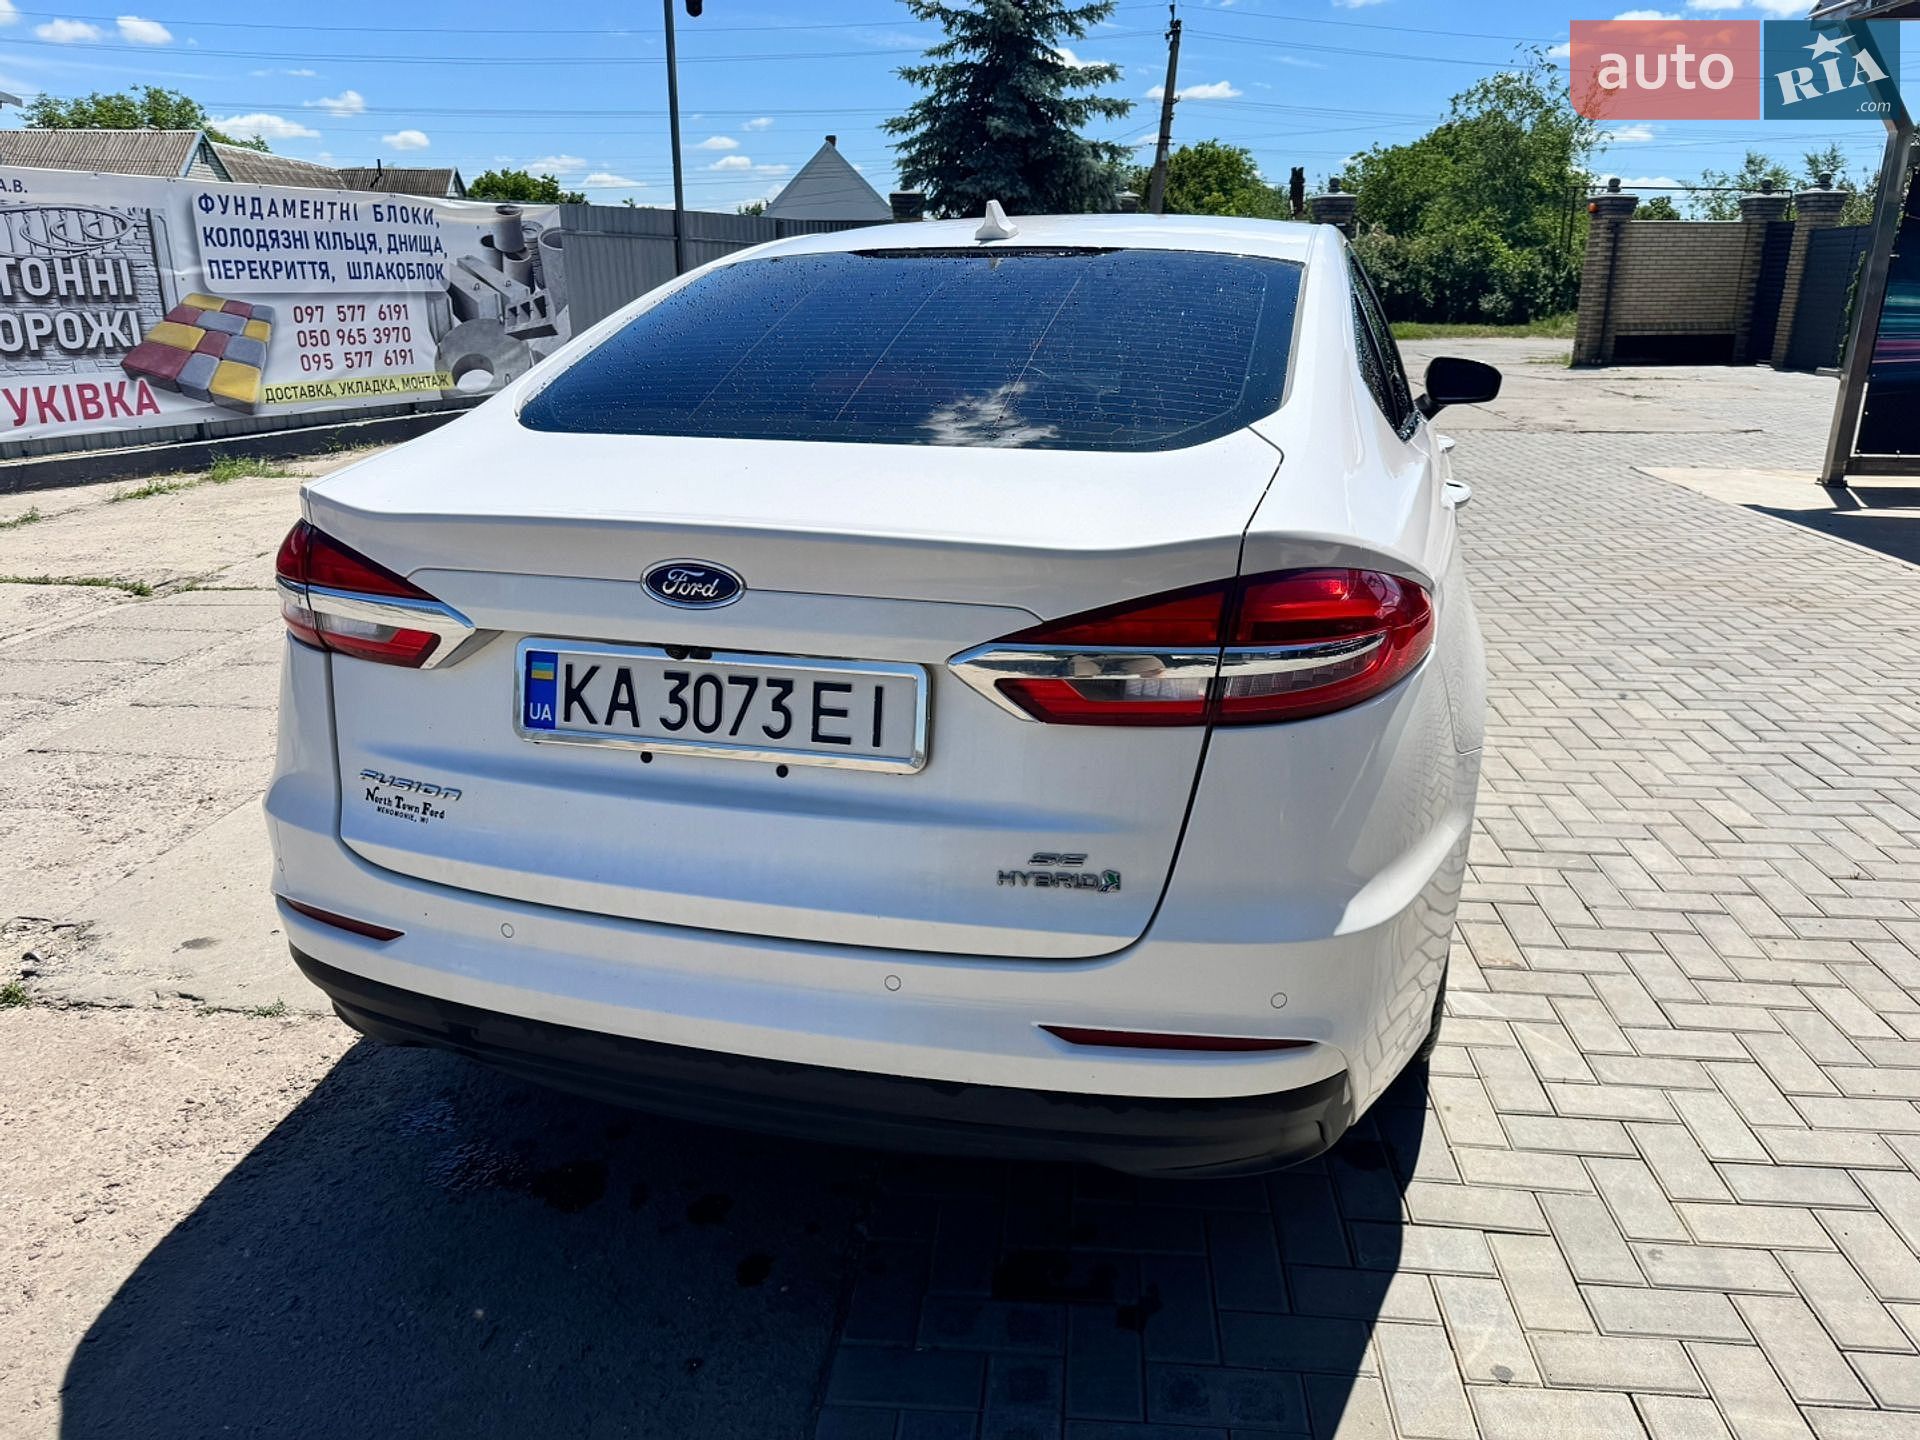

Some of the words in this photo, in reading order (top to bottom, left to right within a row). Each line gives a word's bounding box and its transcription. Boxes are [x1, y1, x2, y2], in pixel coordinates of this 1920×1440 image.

[198, 193, 359, 222] ФУНДАМЕНТНІ
[373, 204, 440, 229] БЛОКИ,
[203, 227, 310, 252] КОЛОДЯЗНІ
[314, 231, 383, 255] КІЛЬЦЯ,
[387, 234, 448, 259] ДНИЩА,
[208, 259, 336, 283] ПЕРЕКРИТТЯ,
[293, 305, 324, 324] 097
[336, 305, 365, 323] 577
[378, 304, 409, 321] 6191
[297, 329, 330, 348] 050
[336, 328, 367, 346] 965
[372, 326, 411, 344] 3970
[300, 353, 334, 372] 095
[344, 351, 373, 369] 577
[384, 348, 414, 367] 6191
[1, 379, 161, 427] УКІВКА
[265, 384, 337, 404] ДОСТАВКА,
[338, 377, 400, 396] УКЛАДКА,
[401, 374, 450, 390] МОНТАЖ
[662, 569, 720, 597] Ford
[529, 701, 552, 721] UA
[563, 663, 640, 728] KA
[659, 670, 794, 740] 3073
[811, 681, 883, 748] EI
[360, 769, 462, 801] FUSION
[365, 786, 393, 806] North
[394, 795, 420, 813] Town
[421, 801, 446, 820] Ford
[1028, 851, 1089, 867] SE
[996, 870, 1099, 889] HYBRID
